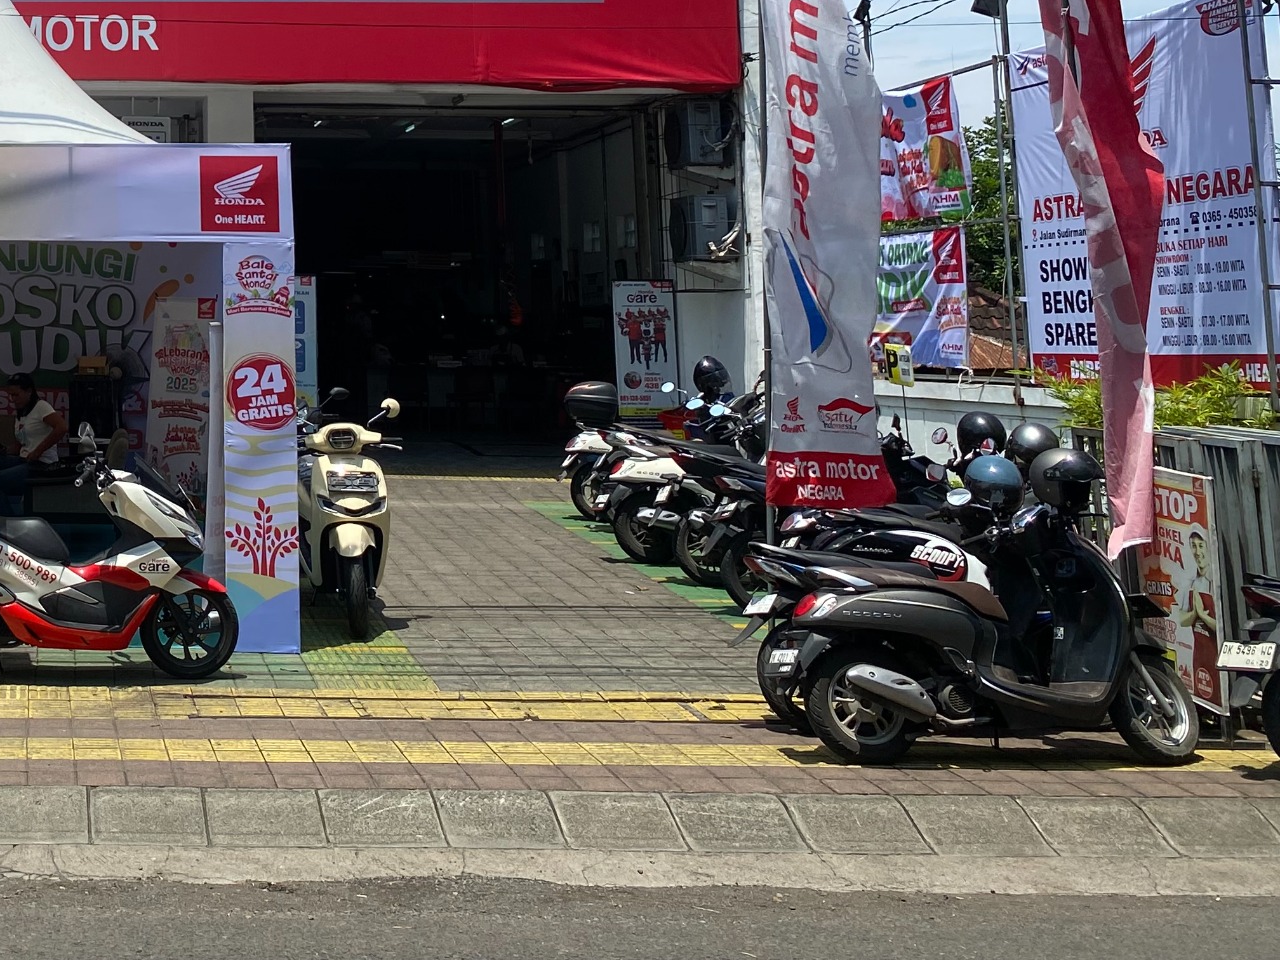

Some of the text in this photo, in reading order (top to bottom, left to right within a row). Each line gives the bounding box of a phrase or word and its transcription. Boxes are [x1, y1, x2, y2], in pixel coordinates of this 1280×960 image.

[1166, 166, 1255, 205] NEGARA
[214, 198, 265, 206] HONDA
[1033, 194, 1085, 223] ASTRA
[215, 214, 266, 224] One HEART.
[1202, 210, 1221, 223] 0365
[1040, 228, 1087, 240] Jalan Sudirman
[1156, 235, 1228, 253] BUKA SETIAP HARI
[238, 260, 274, 270] Bale
[1040, 257, 1087, 282] SHOW
[1230, 259, 1245, 271] WITA
[235, 269, 279, 282] Santai
[243, 279, 271, 290] Honda
[1042, 290, 1093, 314] BENG
[1160, 306, 1186, 315] BENGKEL
[163, 346, 203, 360] Lebaran
[171, 366, 195, 376] Honda
[166, 376, 197, 390] 2025
[234, 364, 287, 398] 24
[248, 394, 278, 407] JAM
[238, 403, 294, 421] GRATIS
[776, 457, 880, 480] astra motor
[797, 484, 845, 500] NEGARA
[910, 545, 965, 569] SCOOPY
[1143, 542, 1185, 570] BUKA
[1146, 580, 1173, 596] GRATIS
[1223, 645, 1273, 656] DK 5496 WC
